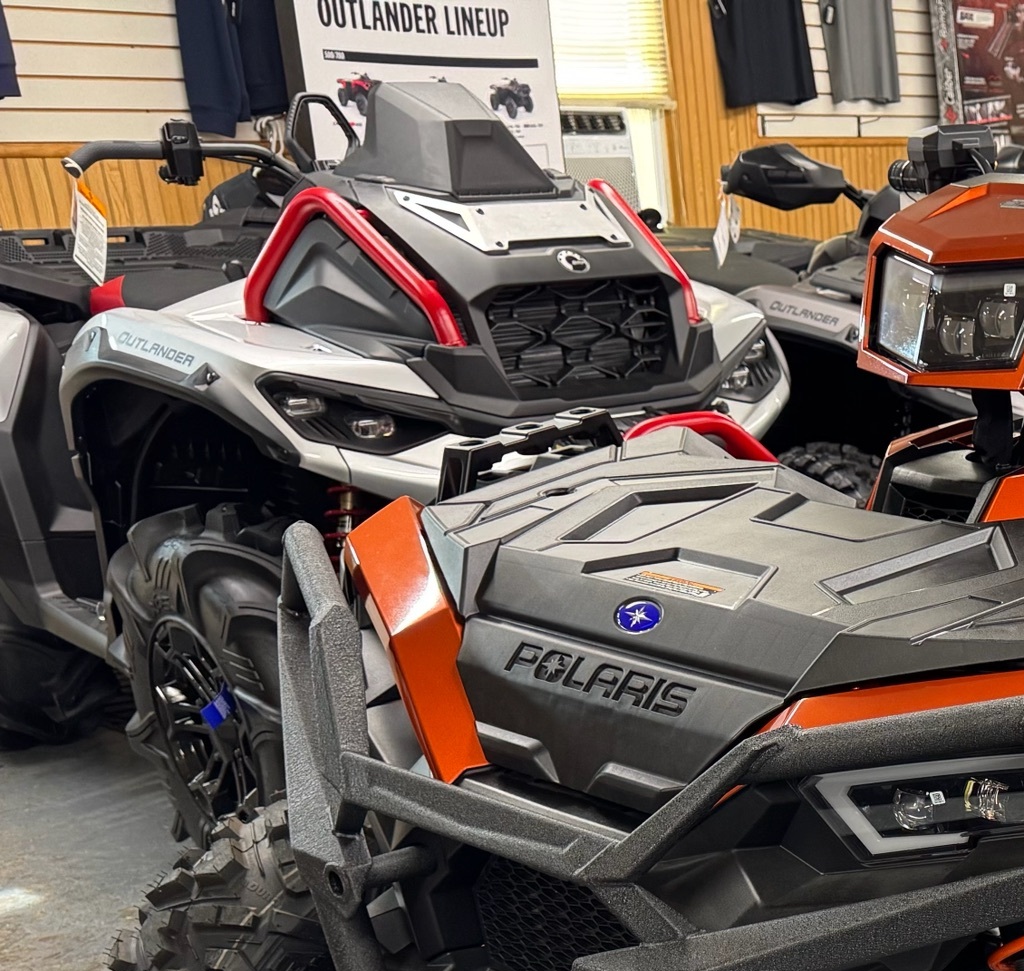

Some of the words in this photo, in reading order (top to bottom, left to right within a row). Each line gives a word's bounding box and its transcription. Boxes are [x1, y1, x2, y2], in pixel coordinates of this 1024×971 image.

[317, 0, 439, 35] OUTLANDER
[444, 6, 509, 37] LINEUP
[769, 300, 840, 326] OUTLANDER
[118, 331, 195, 367] OUTLANDER
[503, 641, 697, 718] POLARIS
